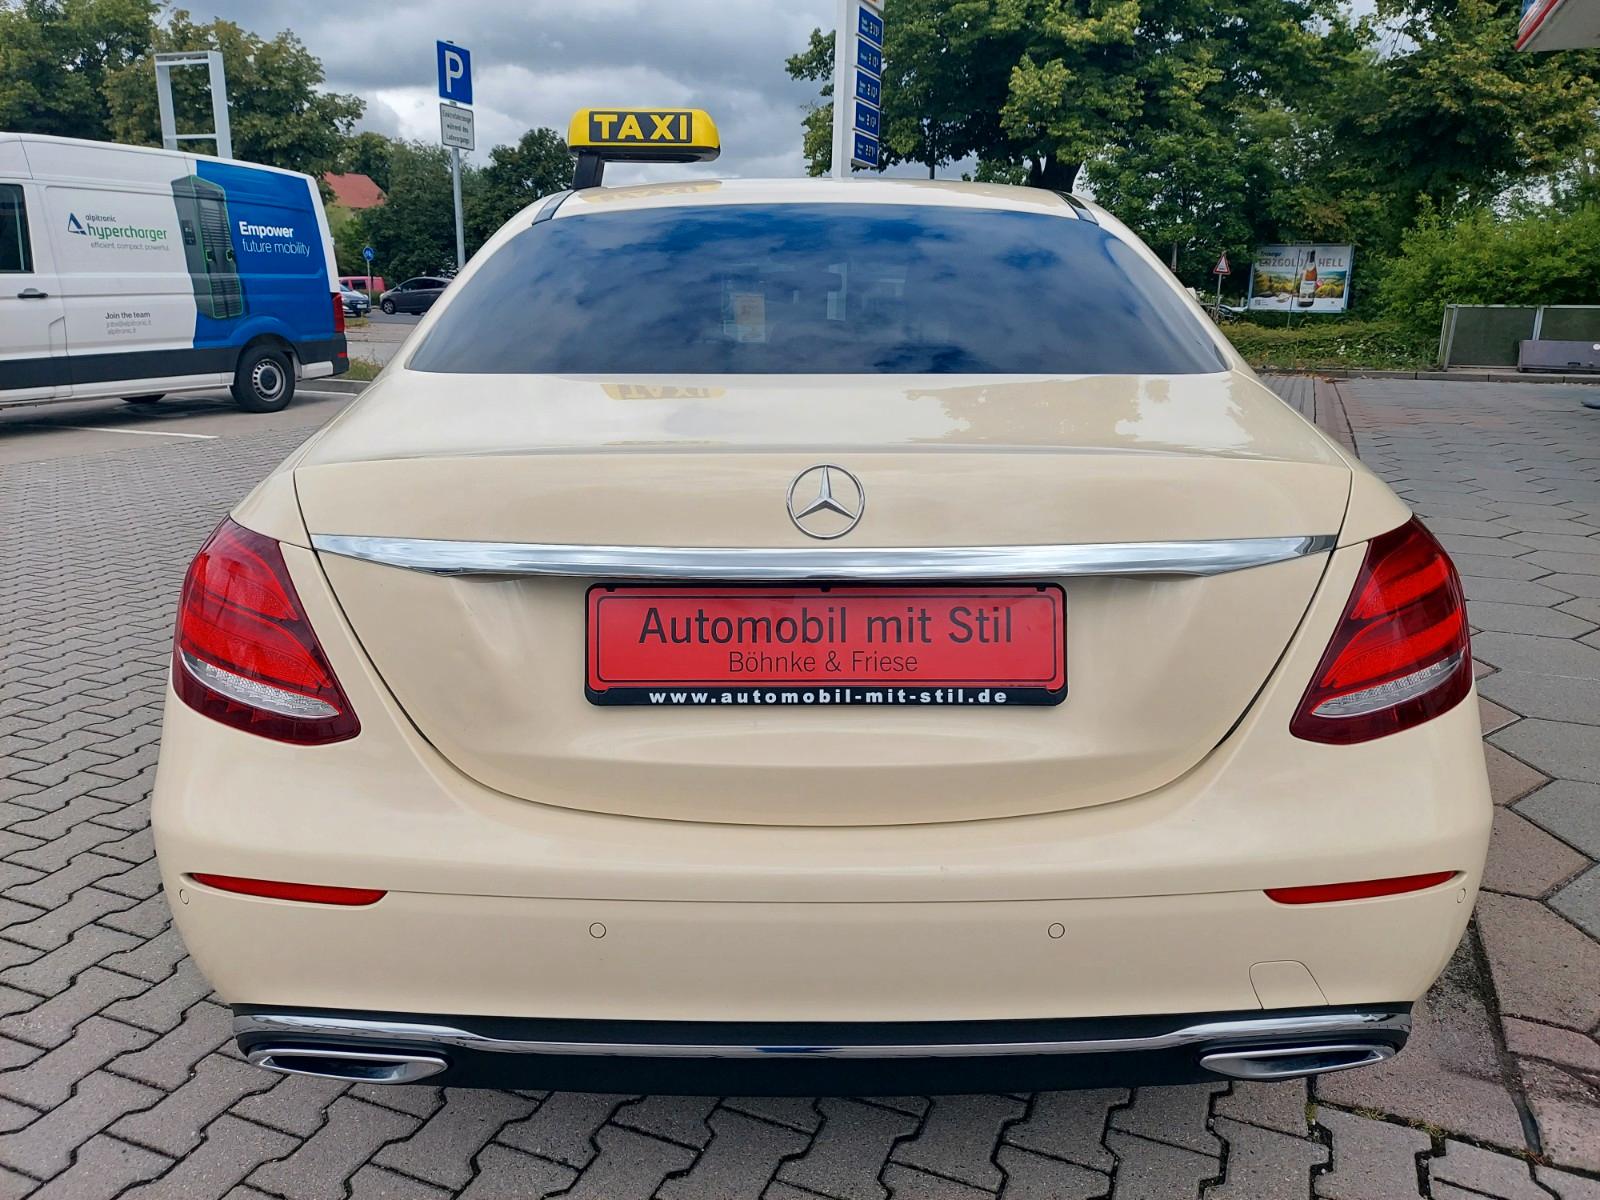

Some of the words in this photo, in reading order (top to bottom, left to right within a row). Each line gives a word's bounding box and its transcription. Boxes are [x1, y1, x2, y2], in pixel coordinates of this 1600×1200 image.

[445, 50, 464, 92] P
[594, 114, 688, 140] TAXI
[87, 222, 167, 241] hypercharger
[239, 221, 294, 239] Empower
[242, 238, 272, 253] future
[274, 241, 311, 257] mobility
[1318, 258, 1345, 268] HELL
[105, 312, 120, 320] Join
[639, 606, 847, 644] Automobil
[867, 606, 932, 644] mit
[948, 606, 1012, 644] Stil
[729, 651, 816, 672] Böhnke
[825, 650, 841, 672] &
[852, 650, 919, 672] Friese
[649, 688, 1008, 704] www.automobil-mit-stil.de
